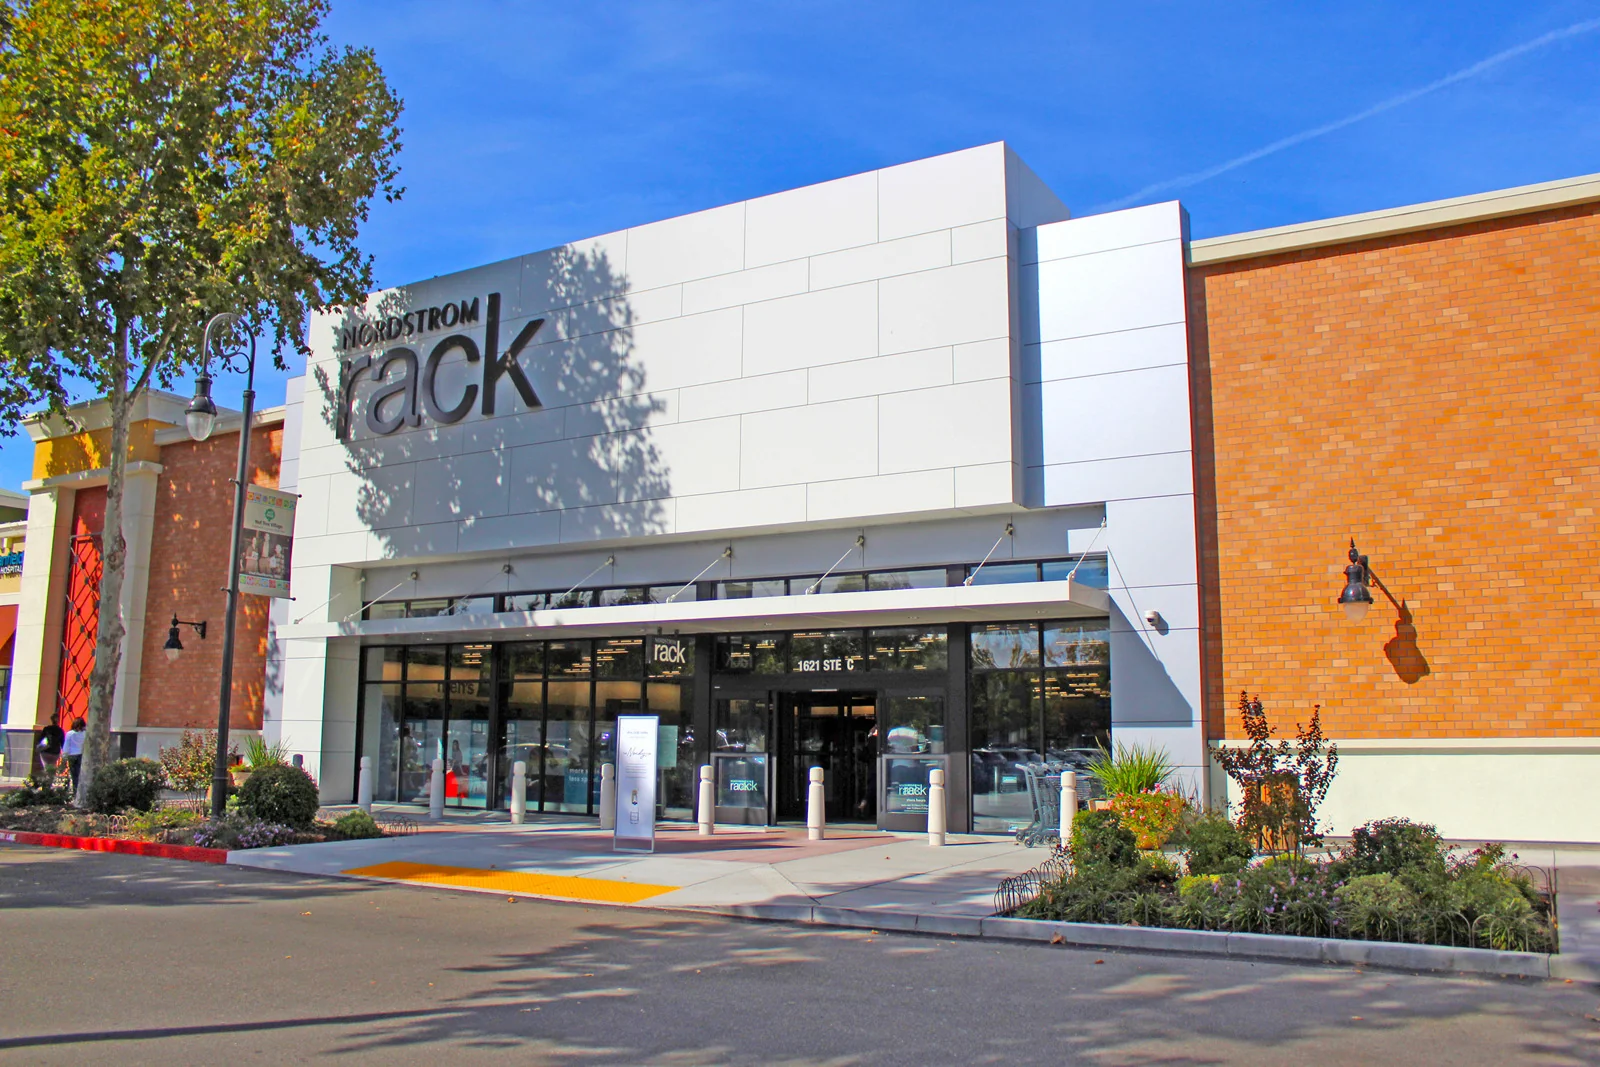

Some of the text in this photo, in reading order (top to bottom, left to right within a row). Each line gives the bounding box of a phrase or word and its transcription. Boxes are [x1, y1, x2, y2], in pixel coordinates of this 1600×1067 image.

[343, 296, 479, 350] NORDSTROM
[336, 292, 545, 440] rack
[654, 640, 686, 664] rack
[797, 658, 855, 672] 1621 STE C
